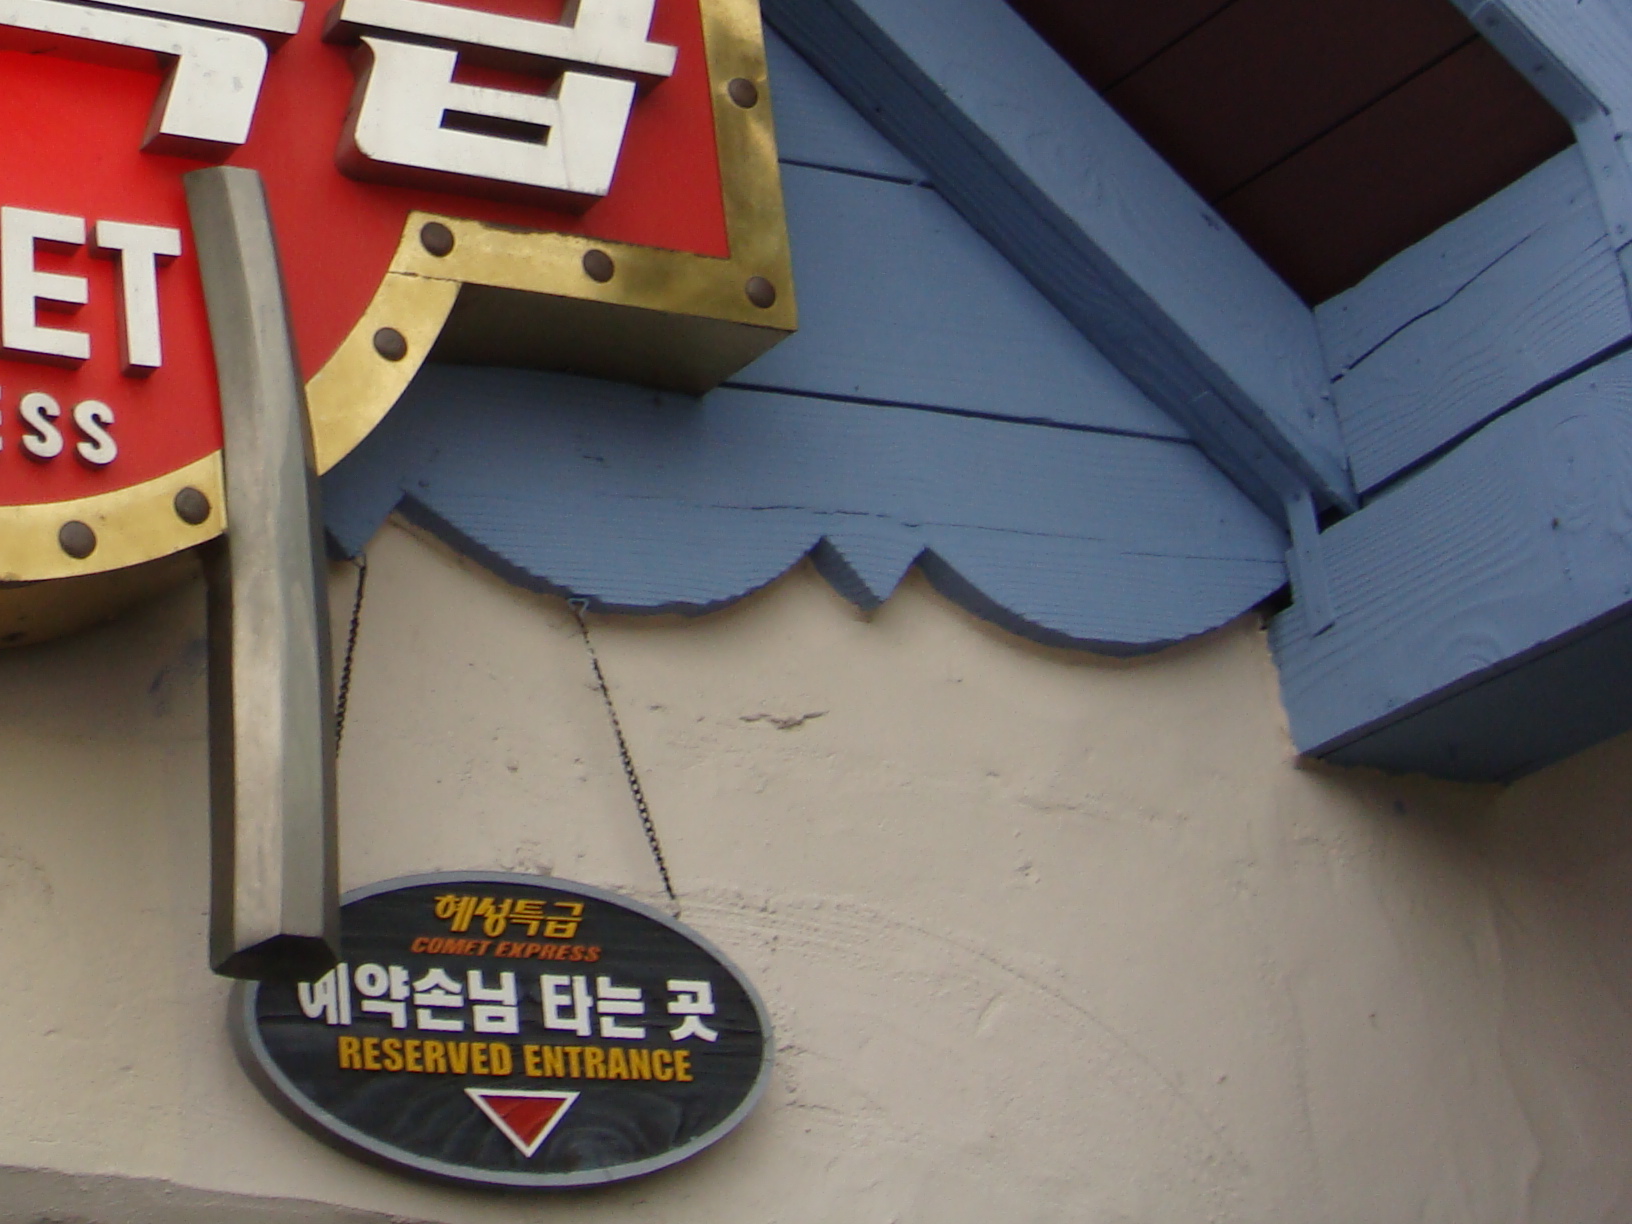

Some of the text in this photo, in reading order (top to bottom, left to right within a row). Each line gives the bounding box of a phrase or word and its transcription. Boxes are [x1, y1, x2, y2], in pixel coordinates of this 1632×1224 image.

[433, 893, 585, 939] 혜성특급
[410, 936, 602, 963] COMET EXPRESS
[297, 961, 719, 1043] 예약손님 타는 곳
[337, 1035, 694, 1082] RESERVED ENTRANCE
